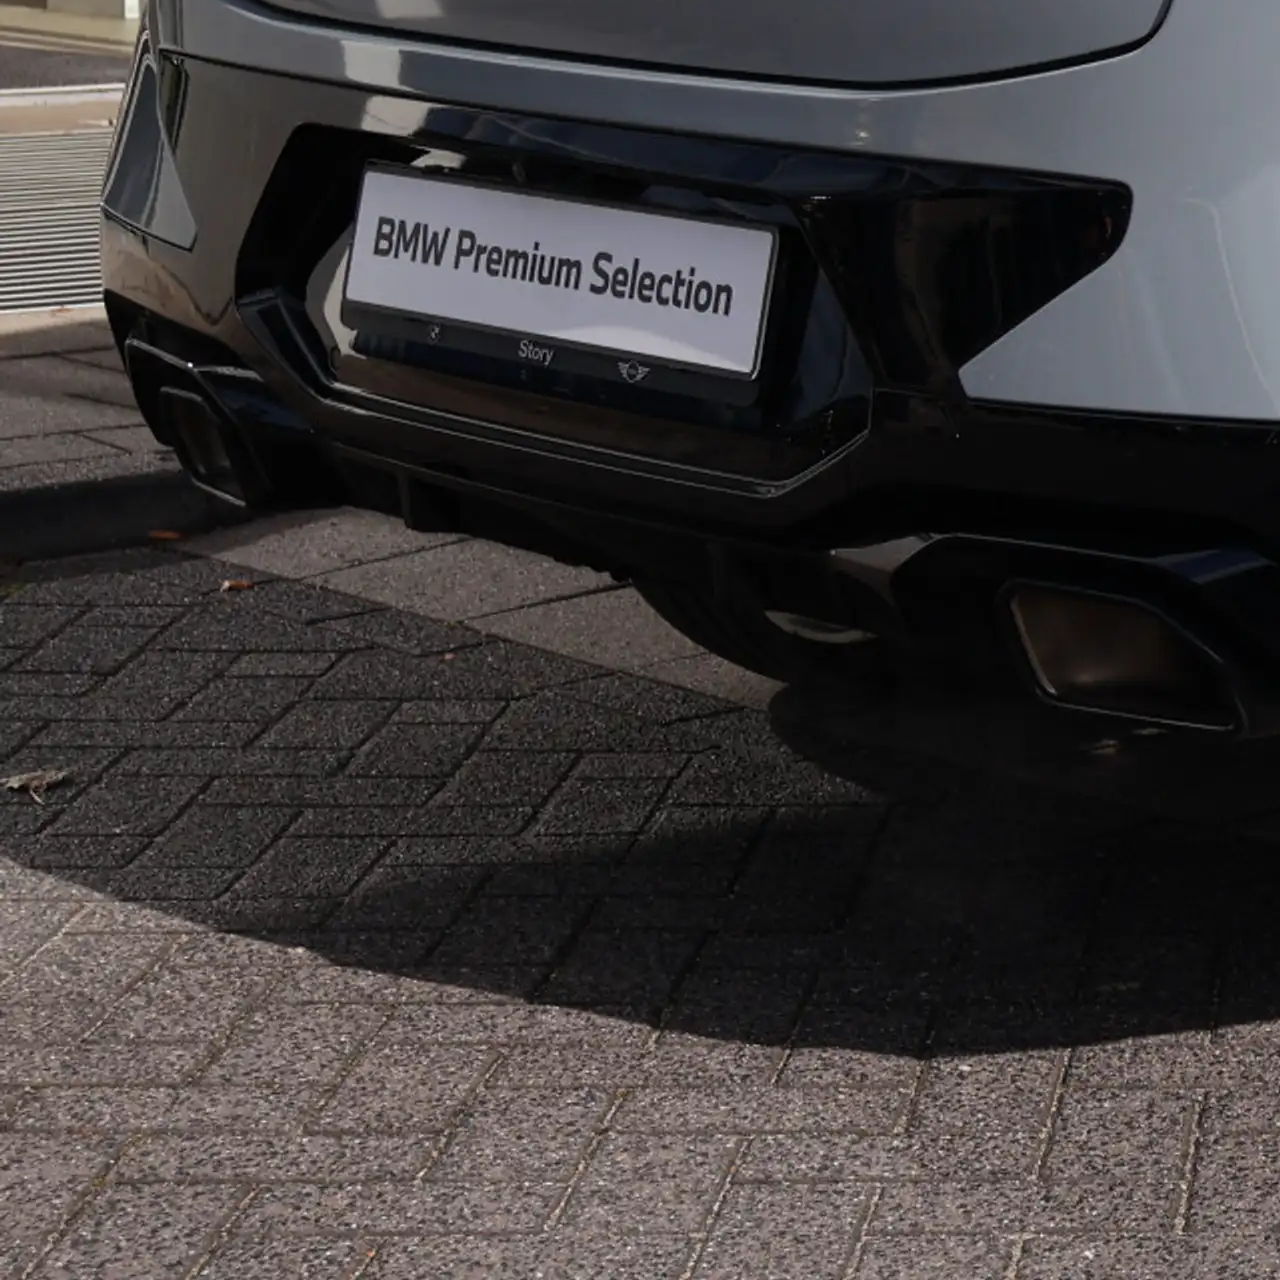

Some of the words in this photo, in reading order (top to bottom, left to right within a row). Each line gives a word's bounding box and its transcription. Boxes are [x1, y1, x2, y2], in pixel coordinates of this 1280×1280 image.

[373, 216, 451, 266] BMW
[454, 230, 581, 290] Premium
[589, 252, 734, 316] Selection
[517, 340, 555, 366] Story
